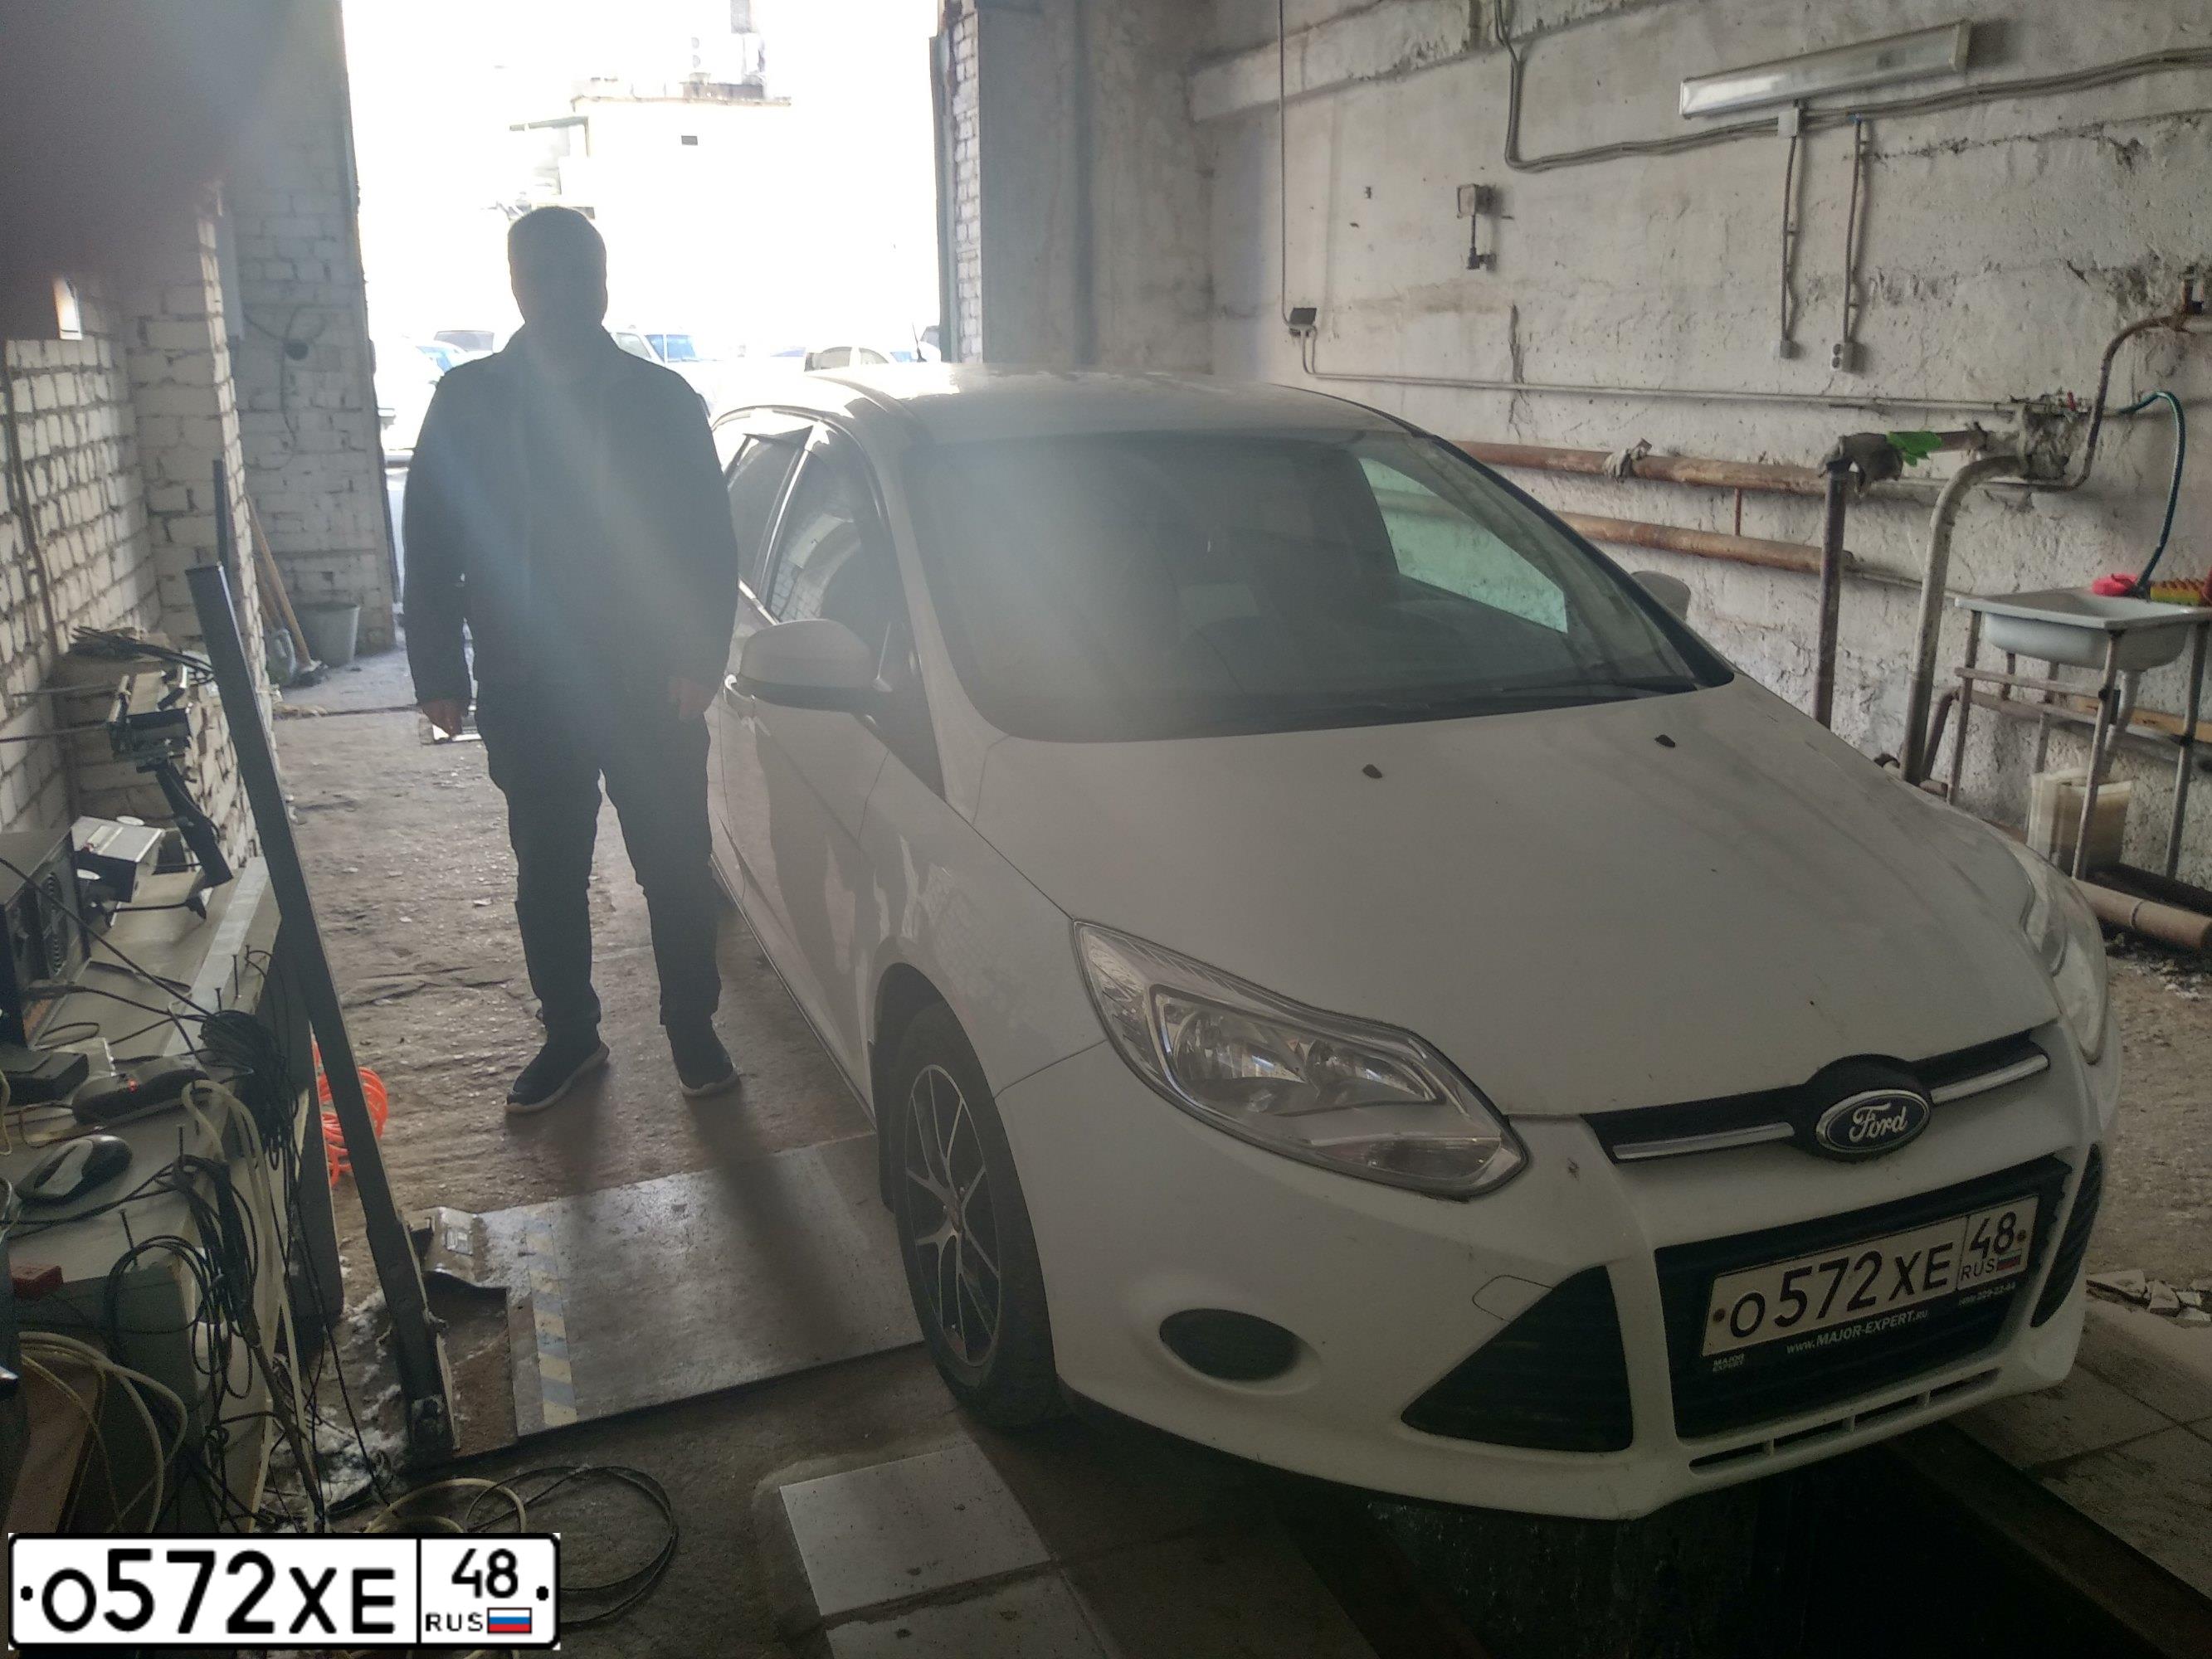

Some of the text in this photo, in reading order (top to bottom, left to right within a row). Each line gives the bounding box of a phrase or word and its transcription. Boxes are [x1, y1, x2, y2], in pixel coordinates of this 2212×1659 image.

[1849, 1102, 1908, 1142] Ford
[1729, 1212, 2016, 1338] O572XE 48
[1961, 1258, 1995, 1281] RUS
